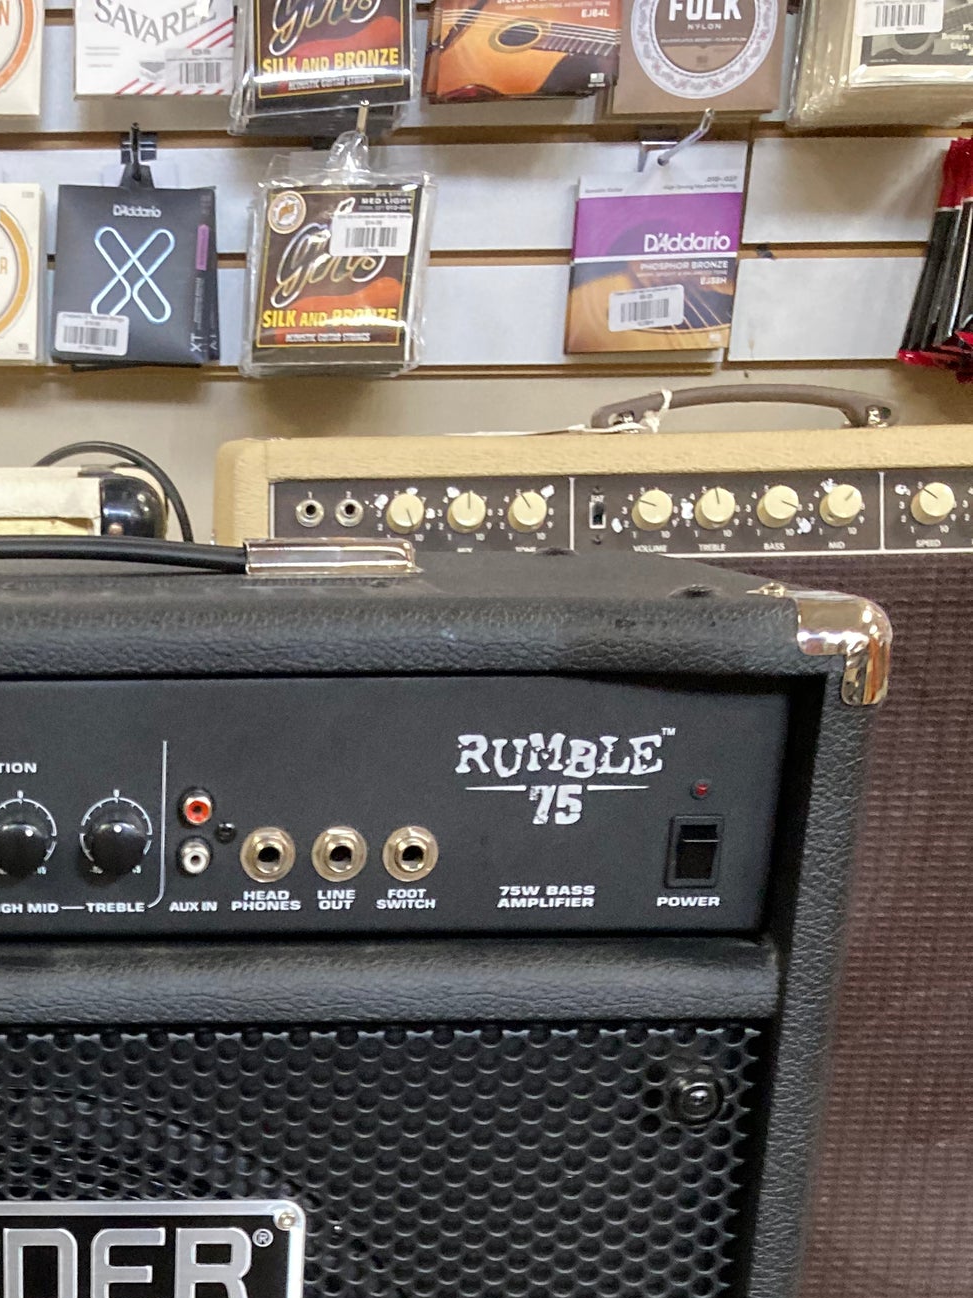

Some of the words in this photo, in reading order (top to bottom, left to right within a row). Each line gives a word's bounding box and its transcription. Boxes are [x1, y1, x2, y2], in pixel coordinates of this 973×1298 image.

[668, 0, 742, 21] FOLK
[94, 0, 217, 45] SAVAREZ
[262, 57, 298, 74] SILK
[301, 56, 330, 74] AND
[334, 47, 399, 69] BRONZE
[112, 203, 162, 218] D'Addario
[643, 231, 731, 253] D'Addario
[639, 261, 690, 271] PHOSPHOR
[691, 260, 729, 269] BRONZE
[262, 309, 297, 328] SILK
[299, 311, 328, 327] AND
[698, 543, 726, 552] TREBLE
[763, 542, 785, 551] BASS
[828, 541, 845, 549] MID
[915, 539, 942, 547] SPEED
[632, 545, 668, 553] VOLUME
[454, 732, 664, 779] RUMBLE
[529, 784, 584, 825] 75
[243, 890, 290, 901] HEAD
[316, 889, 356, 900] LINE
[387, 888, 427, 899] FOOT
[499, 885, 541, 896] 75W
[545, 885, 596, 896] BASS
[169, 901, 201, 912] AUX
[201, 901, 218, 912] IN
[230, 900, 302, 911] PHONES
[318, 900, 354, 910] OUT
[376, 899, 437, 910] SWITCH
[496, 897, 596, 908] AMPLIFIER
[656, 896, 722, 907] POWER
[27, 903, 60, 914] MID
[85, 902, 146, 913] TREBLE
